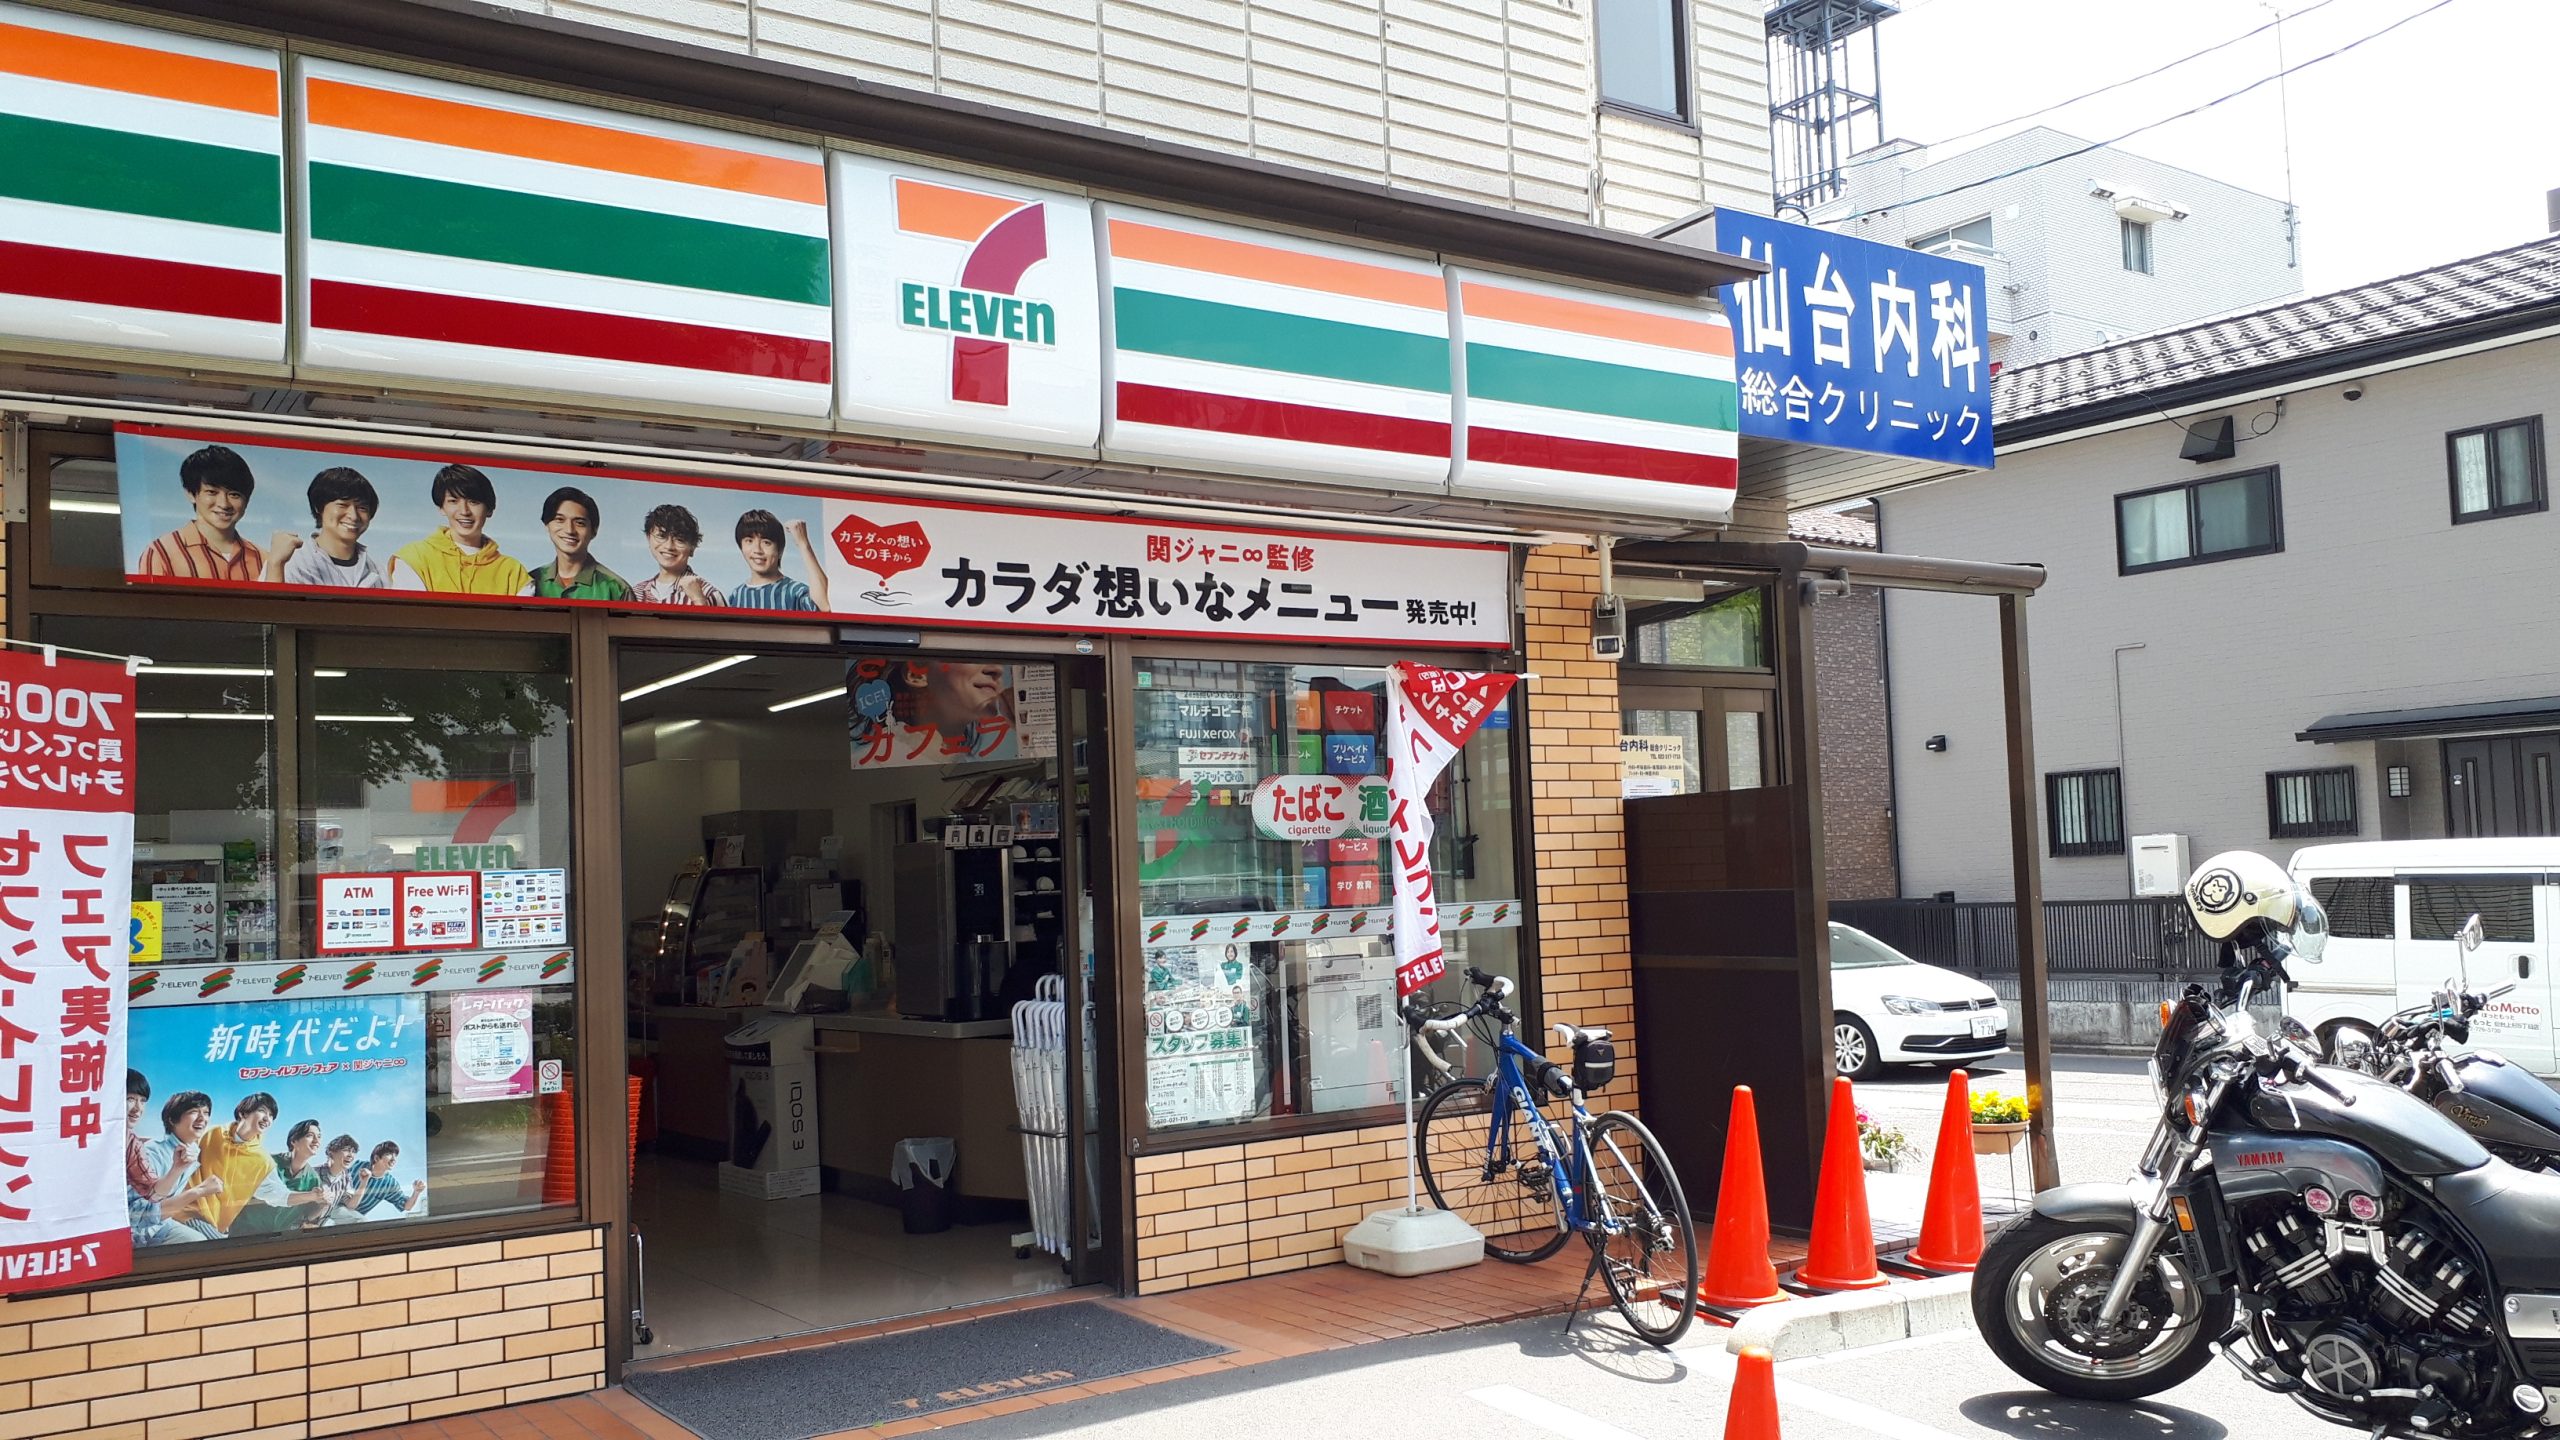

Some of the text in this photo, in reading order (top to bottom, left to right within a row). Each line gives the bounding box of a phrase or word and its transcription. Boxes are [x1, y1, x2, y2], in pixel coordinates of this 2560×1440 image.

[1733, 236, 1980, 393] 仙台内科
[1740, 367, 1980, 446] 総合クリニック
[839, 530, 923, 549] カラダへの想い
[853, 547, 912, 563] この手から
[1147, 534, 1314, 572] 関ジャニ∞監修
[1335, 705, 1363, 715] チケット
[1180, 729, 1200, 739] FUJI
[1620, 739, 1649, 752] 台内科
[1199, 750, 1250, 761] セブンチケット
[1336, 755, 1366, 764] サービス
[1273, 783, 1389, 822] たばこ 酒
[1287, 824, 1390, 836] cigarette liquor
[1338, 842, 1369, 852] サービス
[407, 884, 469, 897] Free Wi-Fi
[1337, 880, 1372, 890] 学び 教育
[344, 887, 374, 899] ATM
[462, 998, 525, 1011] レターパック
[2482, 1003, 2540, 1016] to Motto
[204, 1014, 405, 1062] 新時代だよ!
[1152, 1029, 1249, 1056] スタッフ募集!
[790, 1081, 805, 1151] IQOS 3
[2236, 1152, 2285, 1167] YAMAHA
